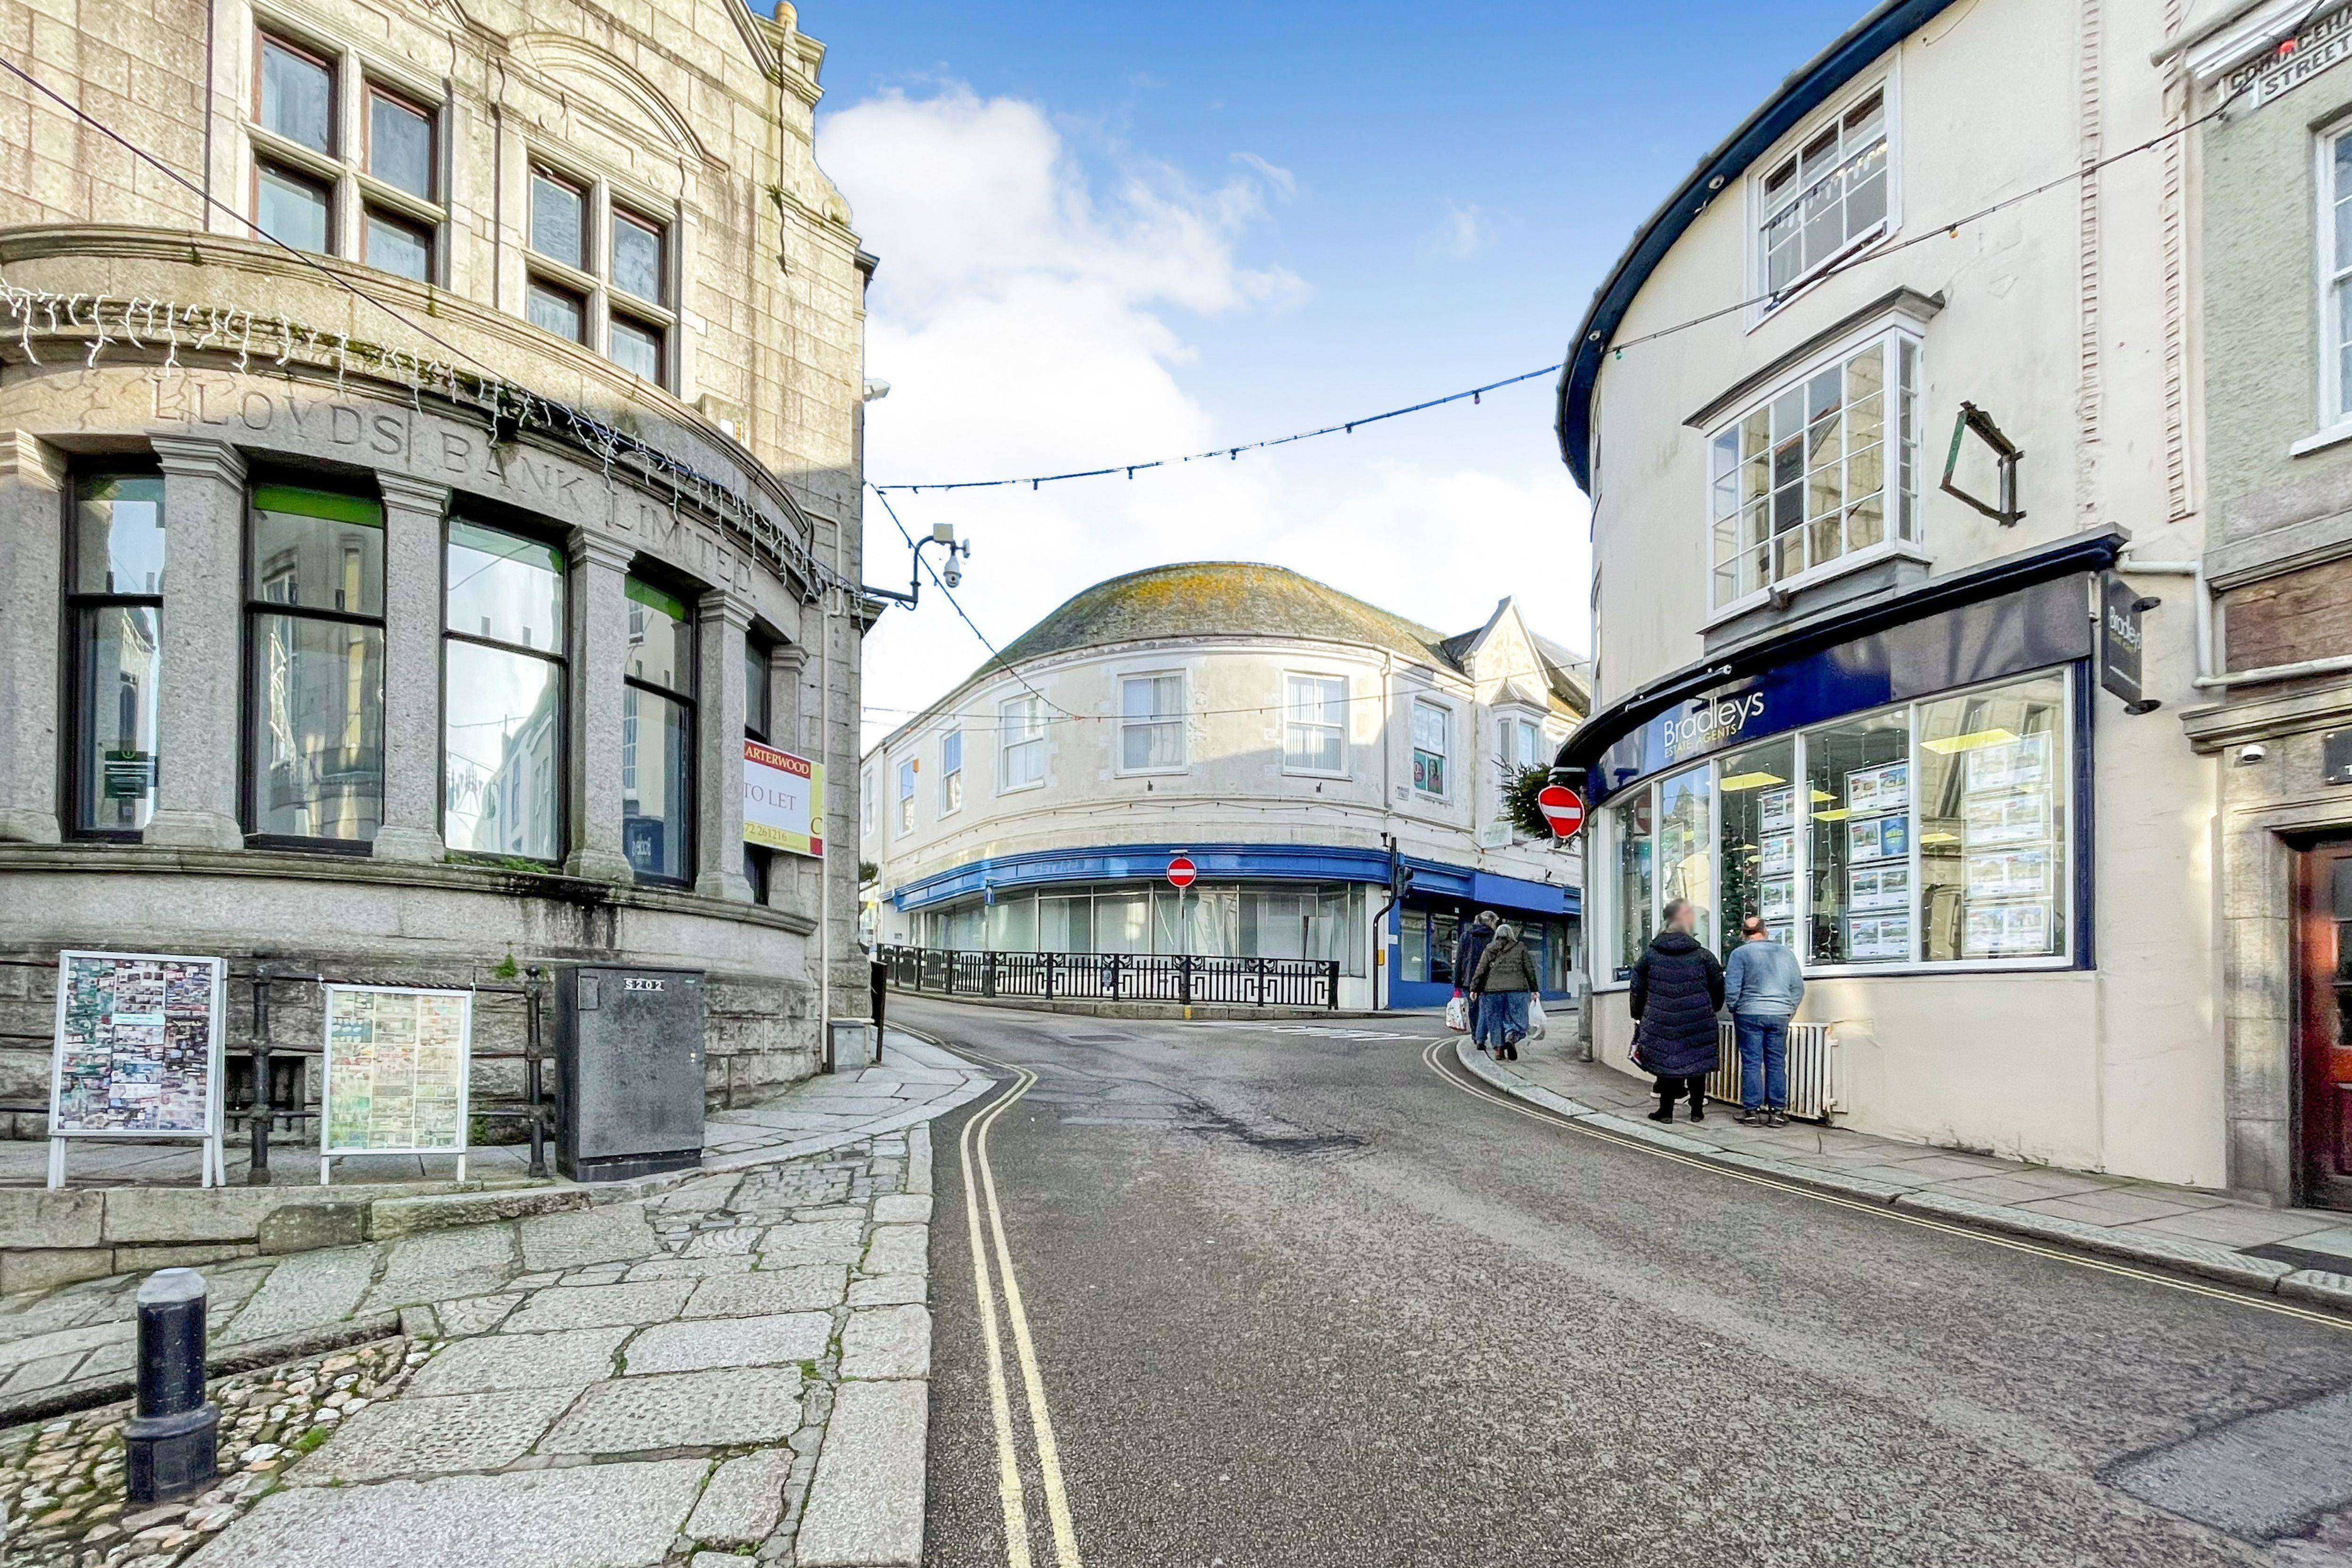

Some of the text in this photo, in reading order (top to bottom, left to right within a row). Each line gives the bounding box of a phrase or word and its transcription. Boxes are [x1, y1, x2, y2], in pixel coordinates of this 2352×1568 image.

[2265, 33, 2352, 96] STREET
[153, 379, 405, 455] LLOYDS
[441, 432, 586, 514] BANK
[1664, 691, 1765, 748] Bradleys
[1664, 723, 1737, 758] ESTATE AGENTS
[745, 782, 796, 811] TO LET
[626, 980, 662, 990] S202
